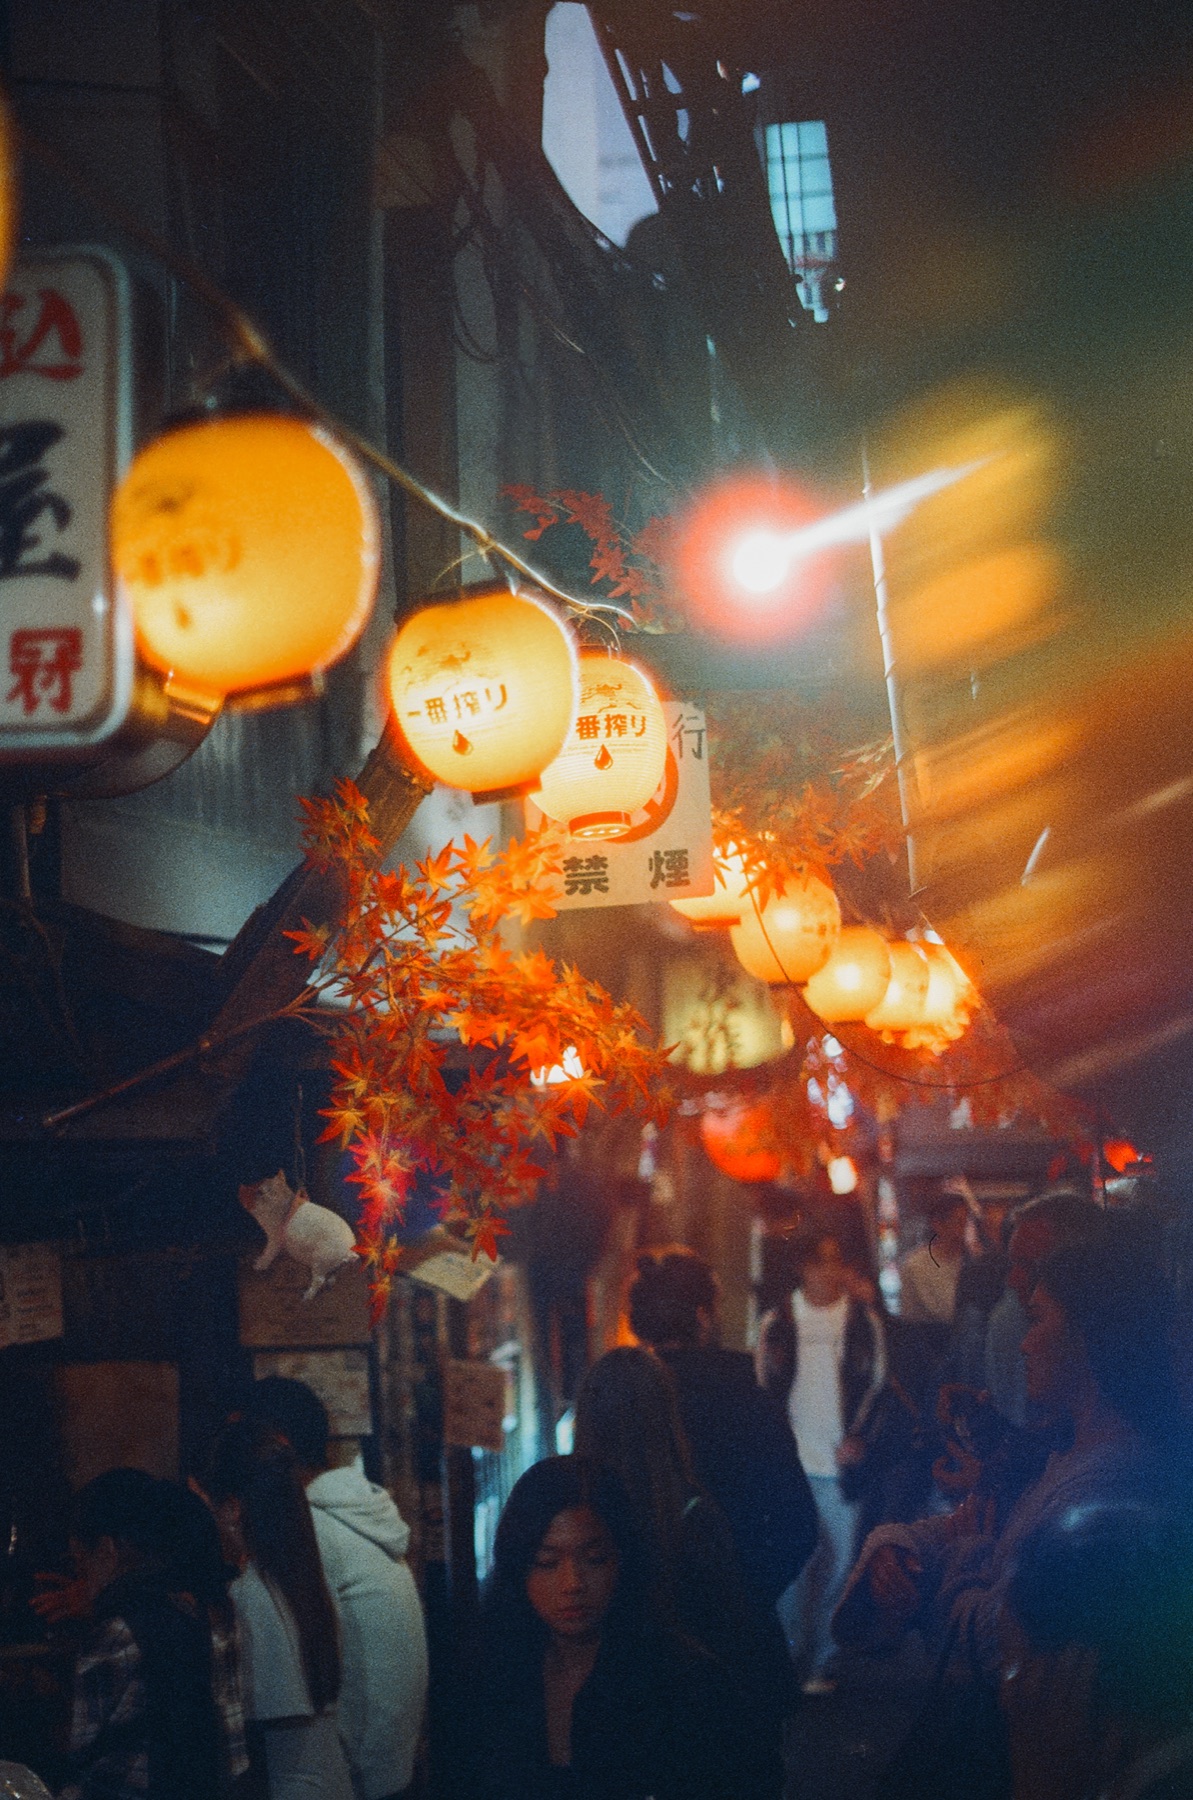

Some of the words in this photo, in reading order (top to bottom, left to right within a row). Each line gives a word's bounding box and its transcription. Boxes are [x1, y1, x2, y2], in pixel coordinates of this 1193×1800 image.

[407, 683, 508, 725] 一番搾り
[562, 848, 692, 896] 禁煙
